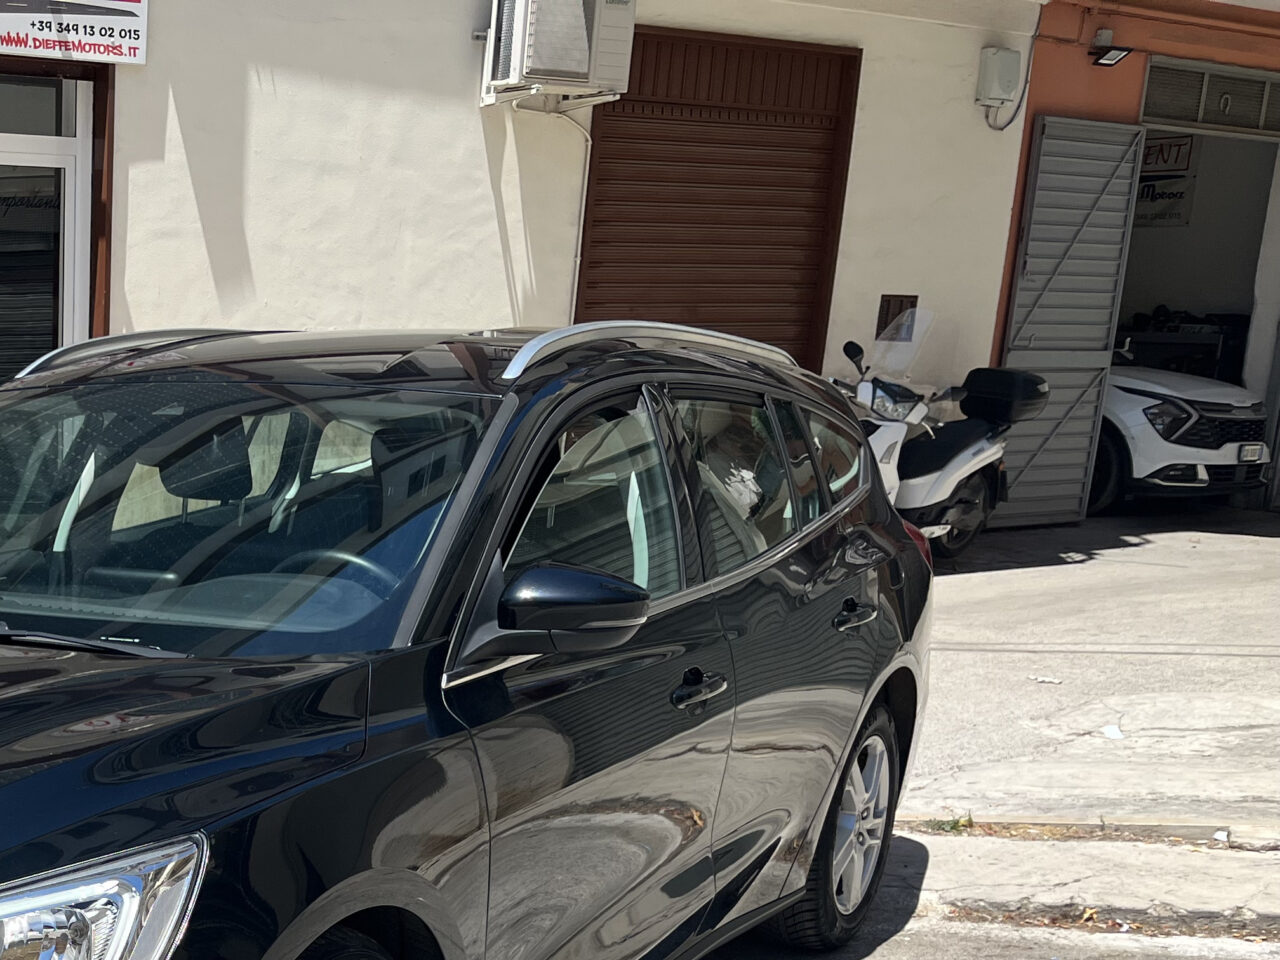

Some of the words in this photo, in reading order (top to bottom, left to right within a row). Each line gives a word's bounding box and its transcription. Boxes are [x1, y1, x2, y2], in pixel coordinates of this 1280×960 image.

[30, 20, 52, 32] +39
[56, 22, 79, 35] 349
[83, 25, 95, 36] 13
[99, 27, 115, 38] 02
[119, 29, 140, 40] 015
[1144, 143, 1188, 165] ENT
